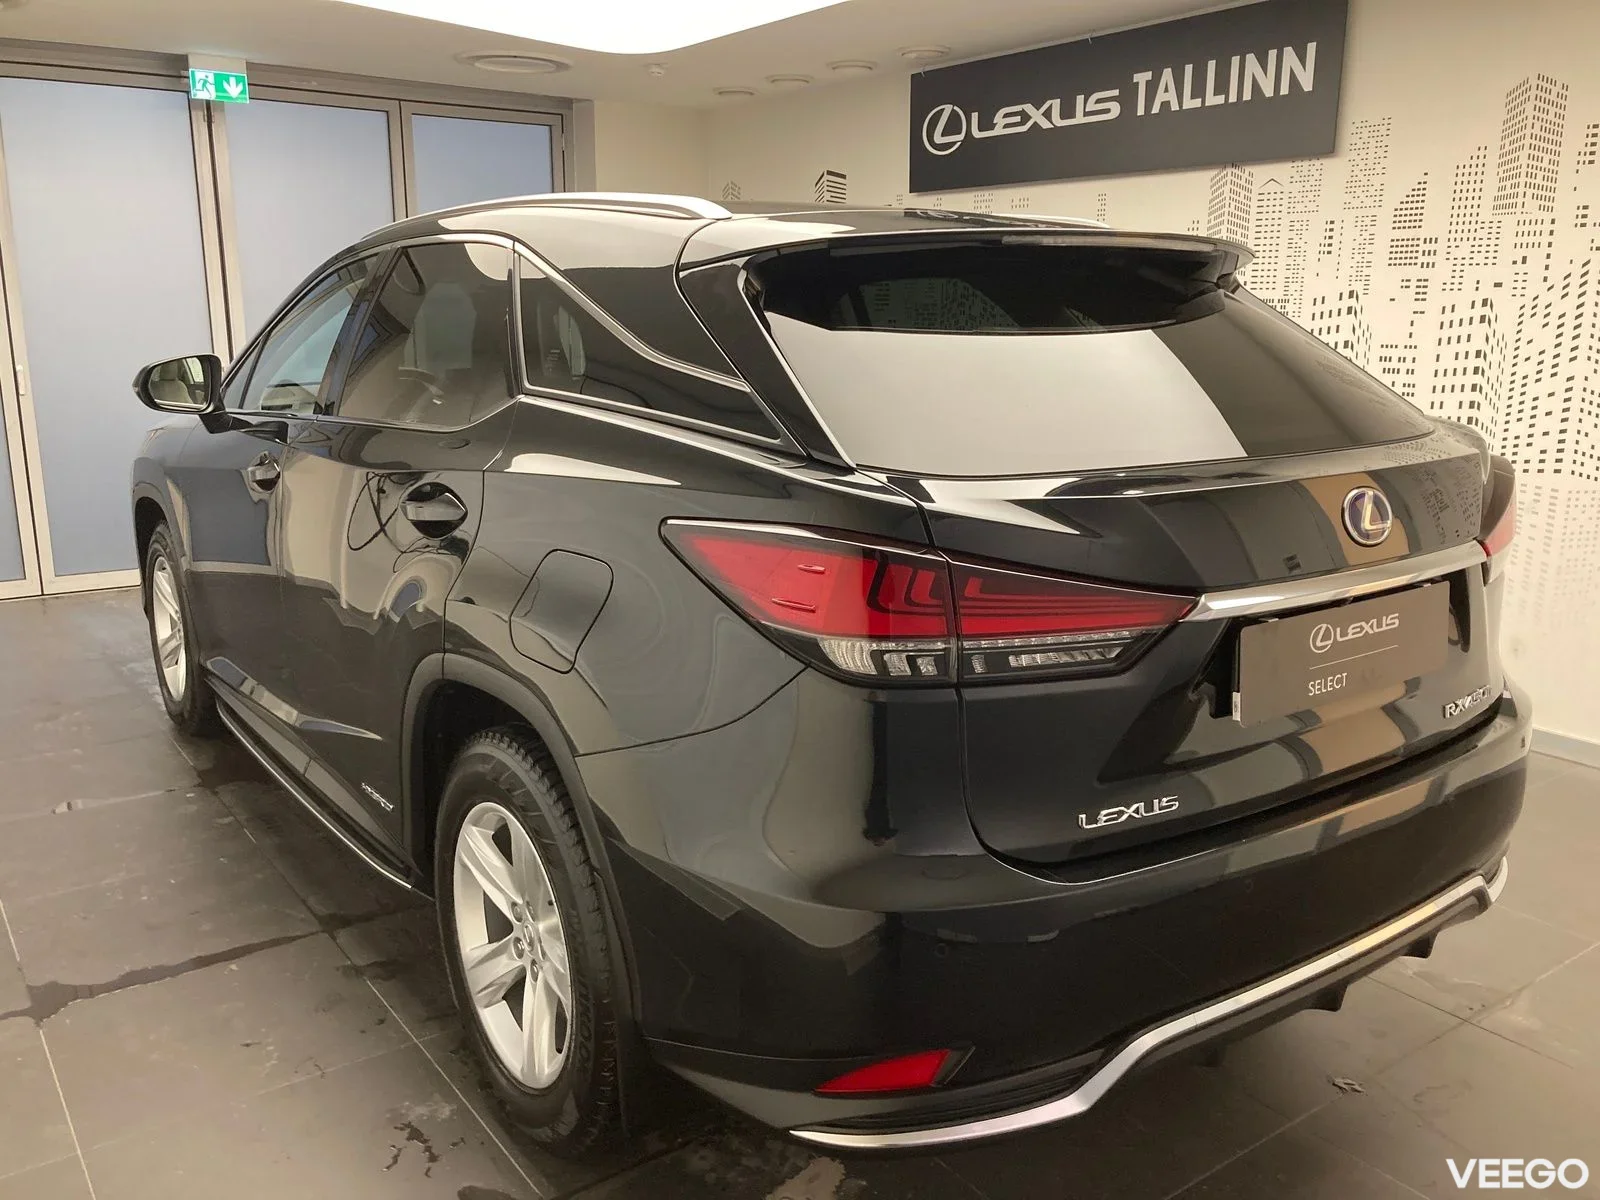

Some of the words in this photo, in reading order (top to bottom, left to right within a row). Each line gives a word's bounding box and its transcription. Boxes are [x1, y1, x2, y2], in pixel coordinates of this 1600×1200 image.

[971, 89, 1121, 139] LEXUS
[1133, 41, 1317, 117] TALLINN
[1336, 613, 1399, 642] LEXUS
[1308, 672, 1347, 696] SELECT
[1078, 796, 1179, 829] LEXUS
